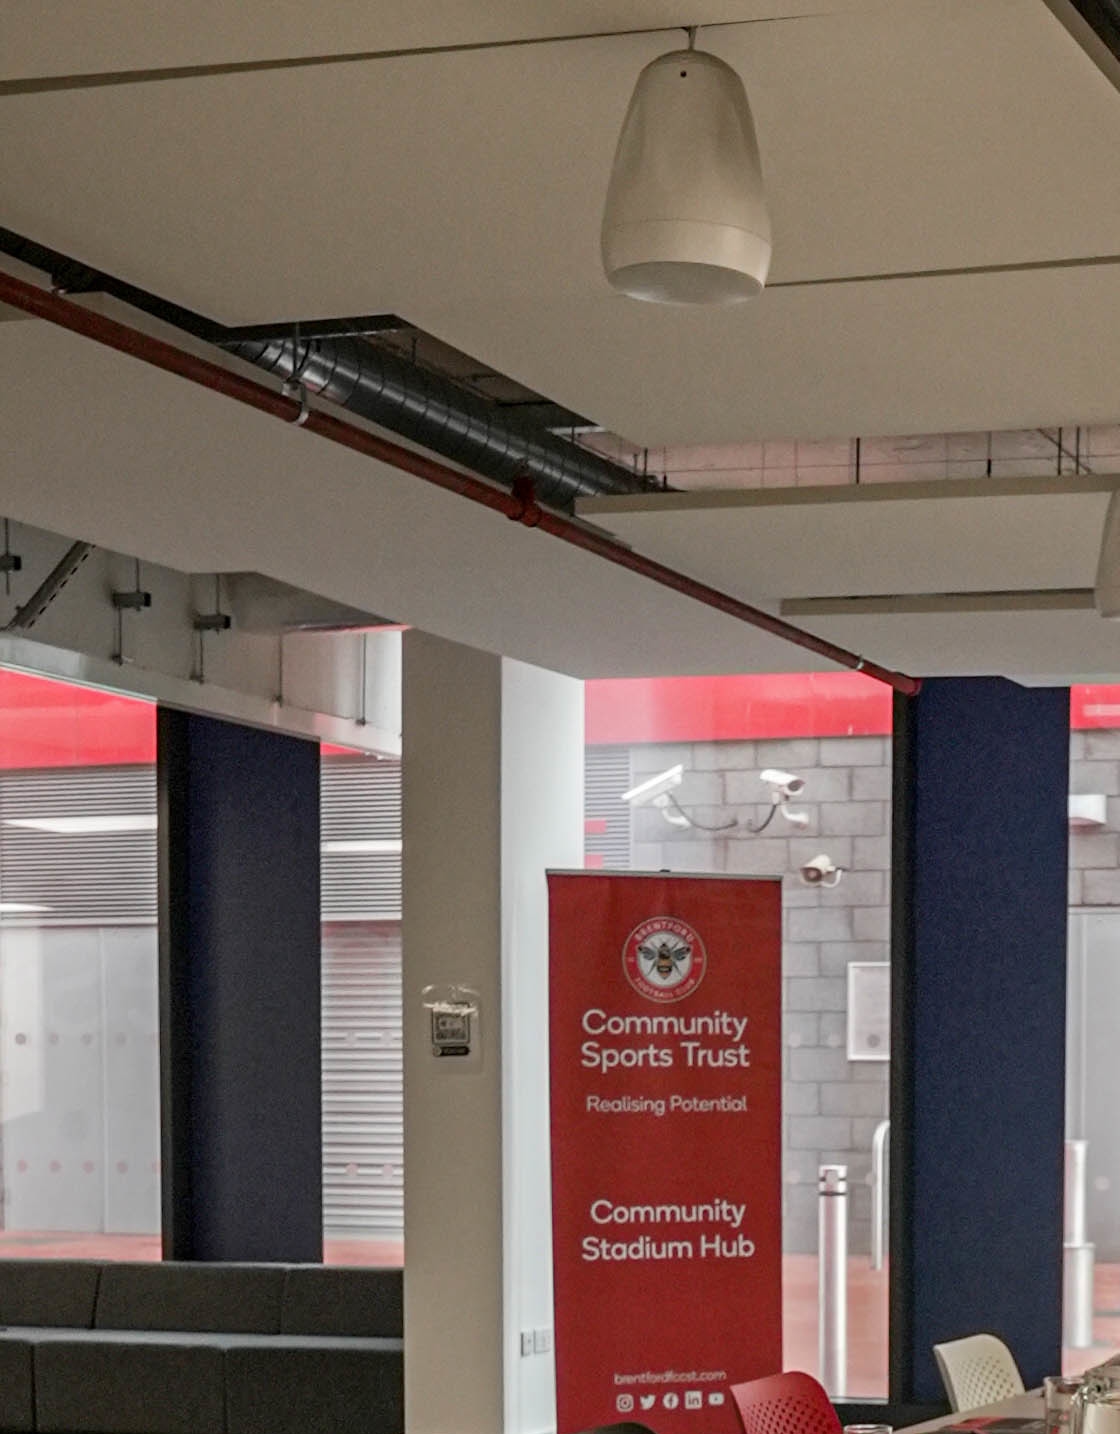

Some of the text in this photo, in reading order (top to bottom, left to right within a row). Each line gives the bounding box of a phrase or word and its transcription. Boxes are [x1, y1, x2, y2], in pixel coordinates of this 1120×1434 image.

[582, 1009, 747, 1042] Community
[581, 1041, 750, 1073] Sports Trust
[586, 1096, 747, 1115] Realising Potential
[590, 1199, 746, 1227] Community
[582, 1235, 755, 1261] Stadium Hub
